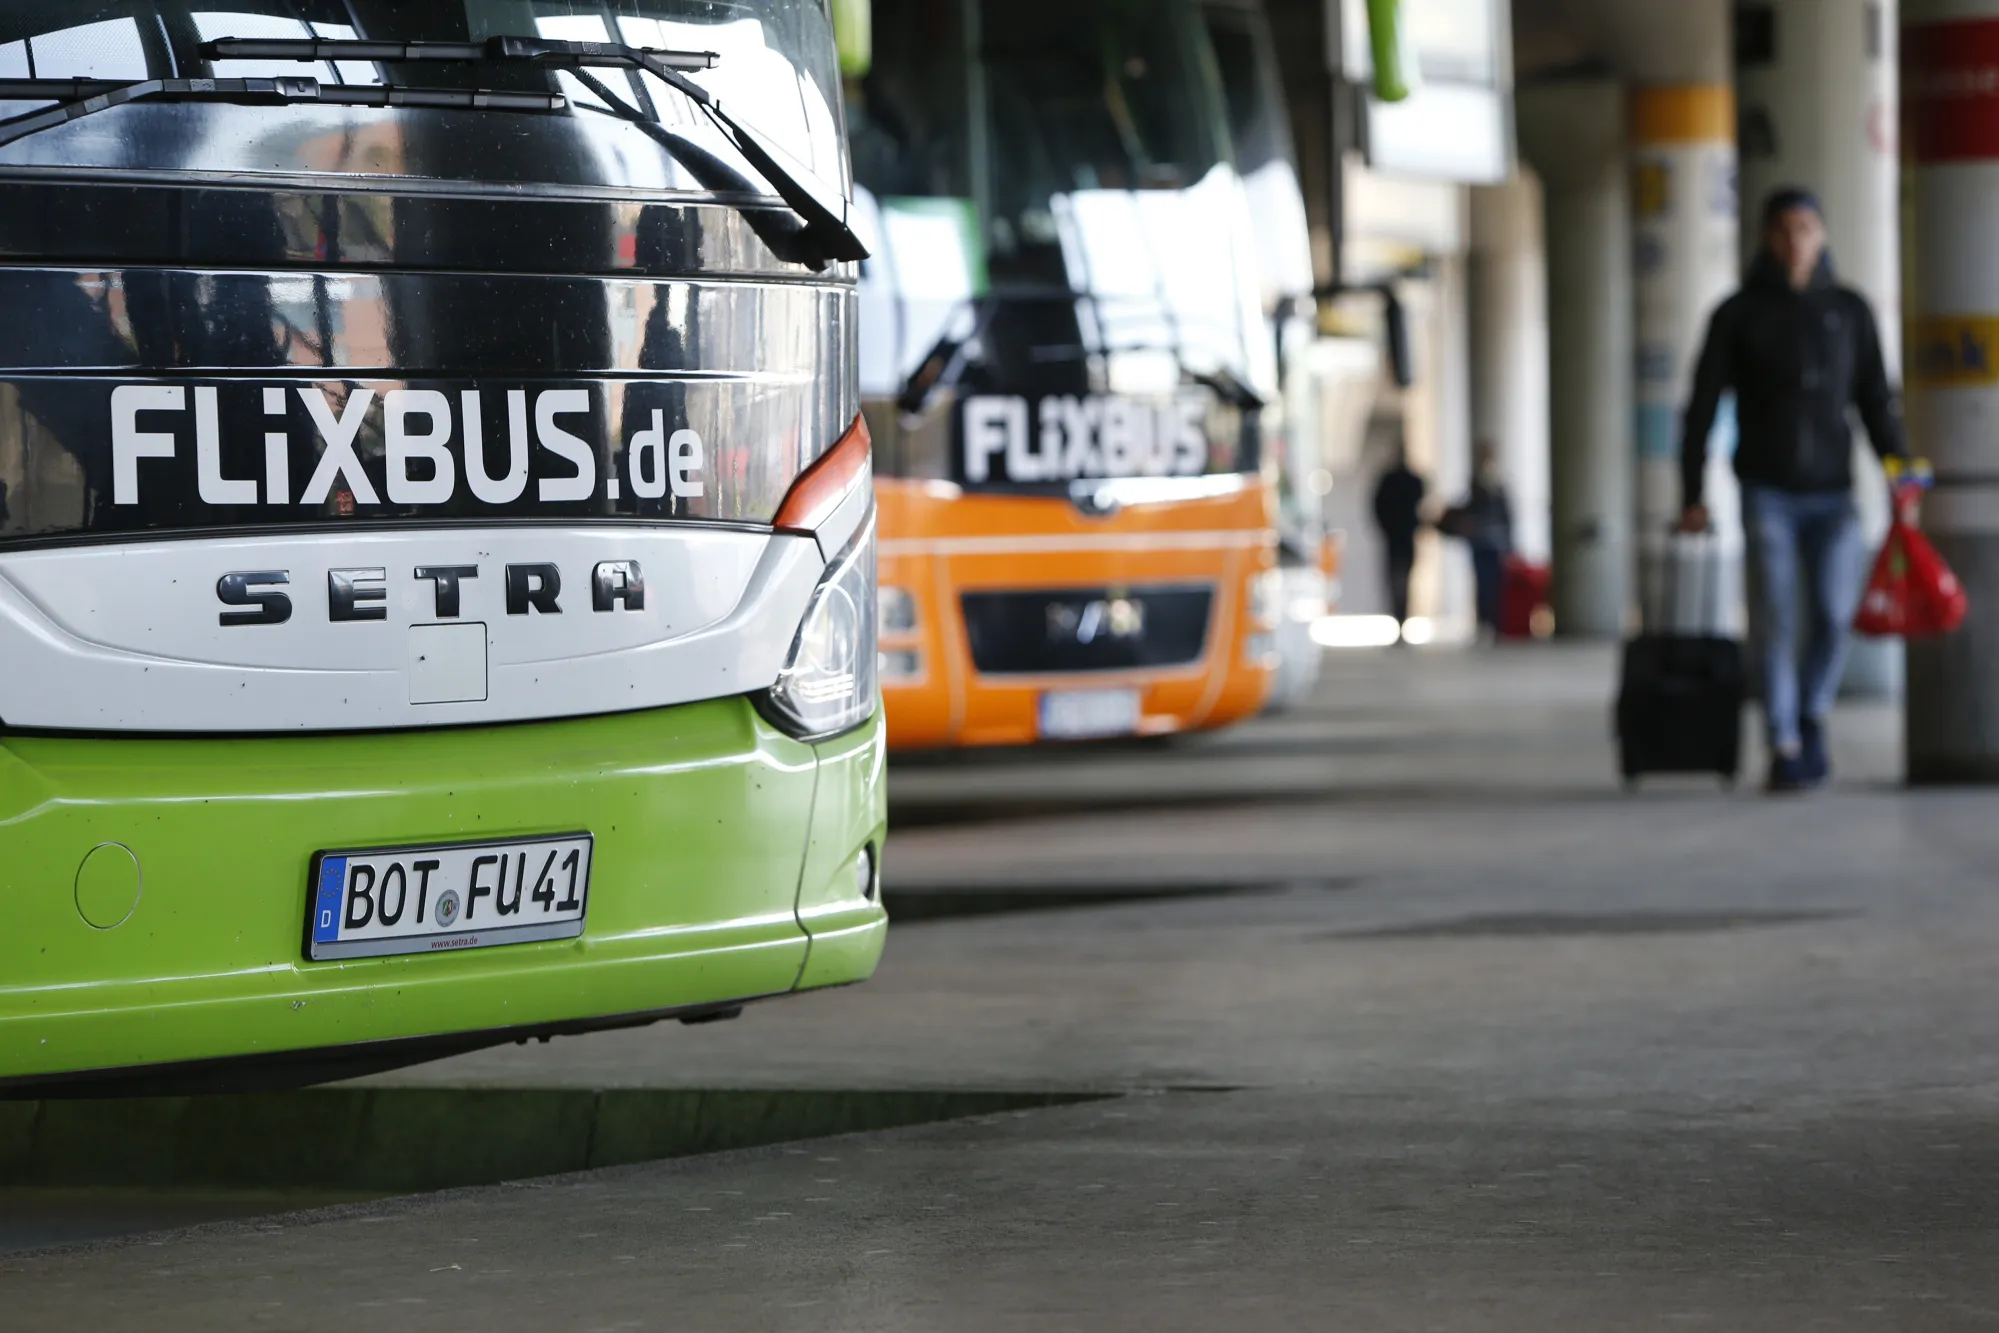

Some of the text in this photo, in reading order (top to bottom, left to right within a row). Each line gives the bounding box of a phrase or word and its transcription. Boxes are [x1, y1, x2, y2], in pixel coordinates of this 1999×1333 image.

[216, 560, 645, 627] SETRA
[320, 911, 331, 928] D
[345, 859, 440, 929] BOT
[431, 936, 478, 949] www.setra.de
